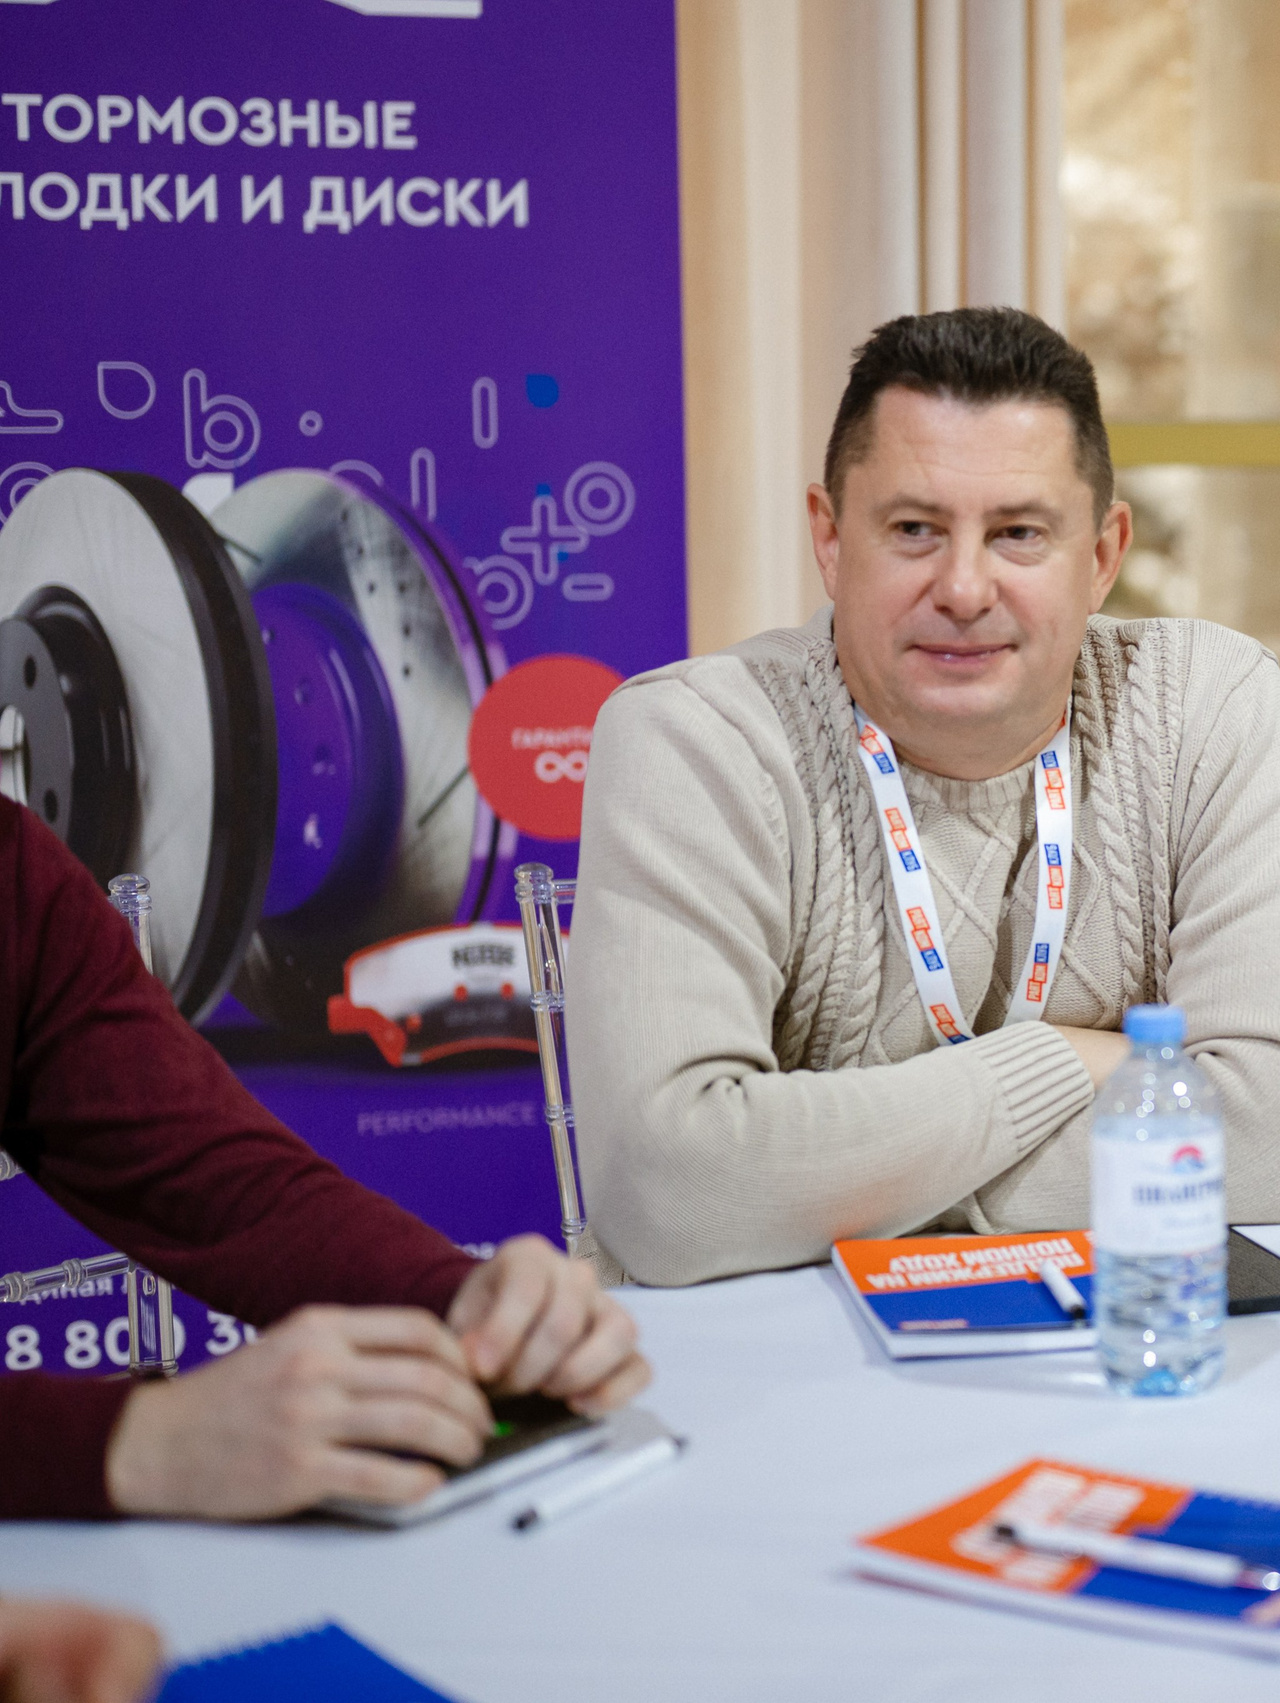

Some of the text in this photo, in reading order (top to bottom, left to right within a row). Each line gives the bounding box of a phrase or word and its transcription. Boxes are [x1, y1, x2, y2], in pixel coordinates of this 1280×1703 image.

[2, 93, 418, 150] ТОРМОЗНЫЕ
[241, 174, 284, 224] И
[303, 176, 530, 234] ДИСКИ
[357, 1103, 537, 1136] PERFORMANCE
[5, 1325, 42, 1371] 8
